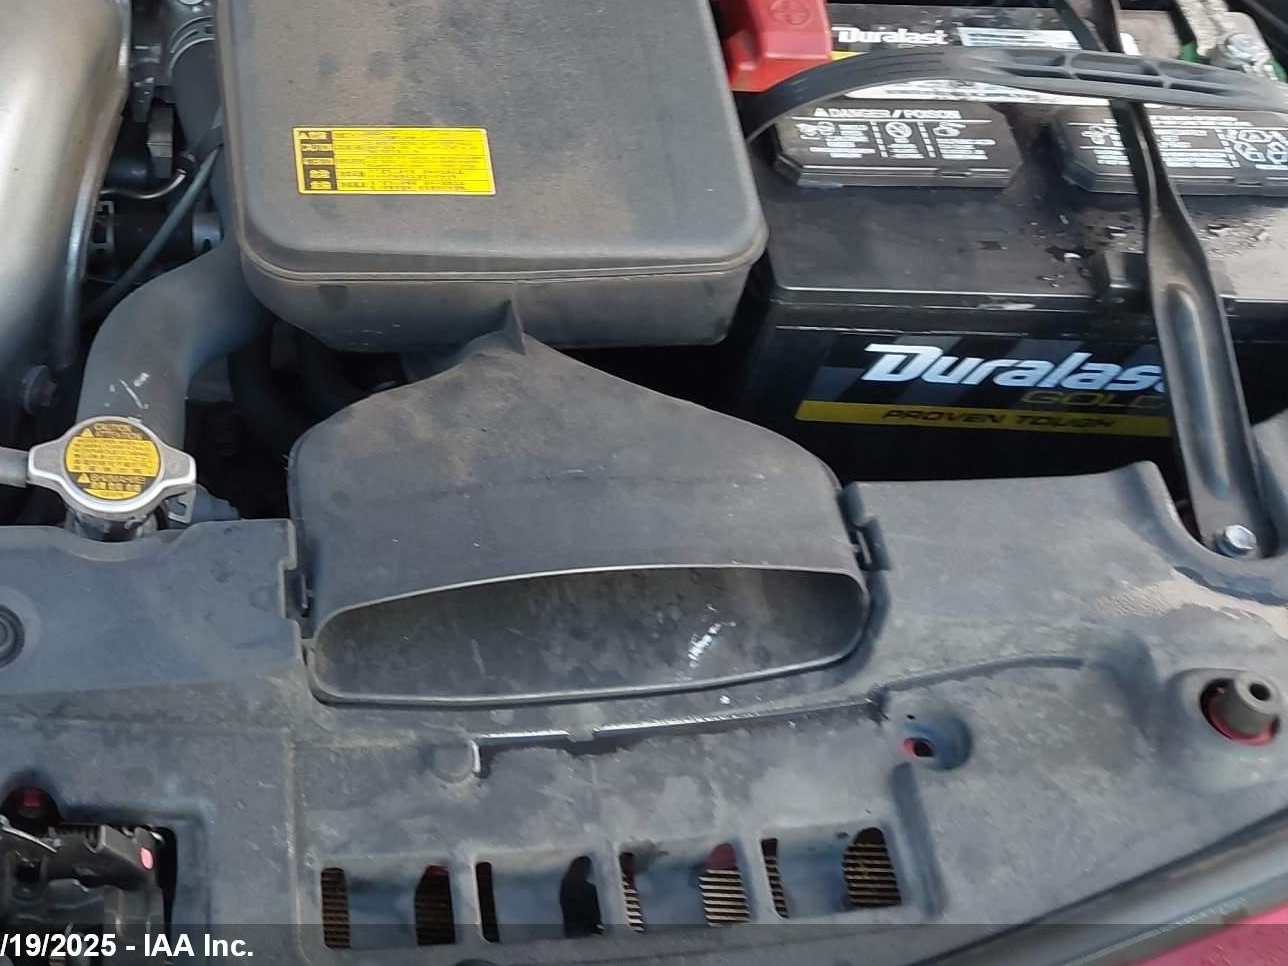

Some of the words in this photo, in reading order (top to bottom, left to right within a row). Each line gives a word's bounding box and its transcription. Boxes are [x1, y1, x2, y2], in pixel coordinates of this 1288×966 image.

[832, 26, 949, 45] Duralast
[861, 343, 1166, 392] Duralas
[882, 409, 1008, 425] PROVEN
[1015, 414, 1119, 429] TOUGH
